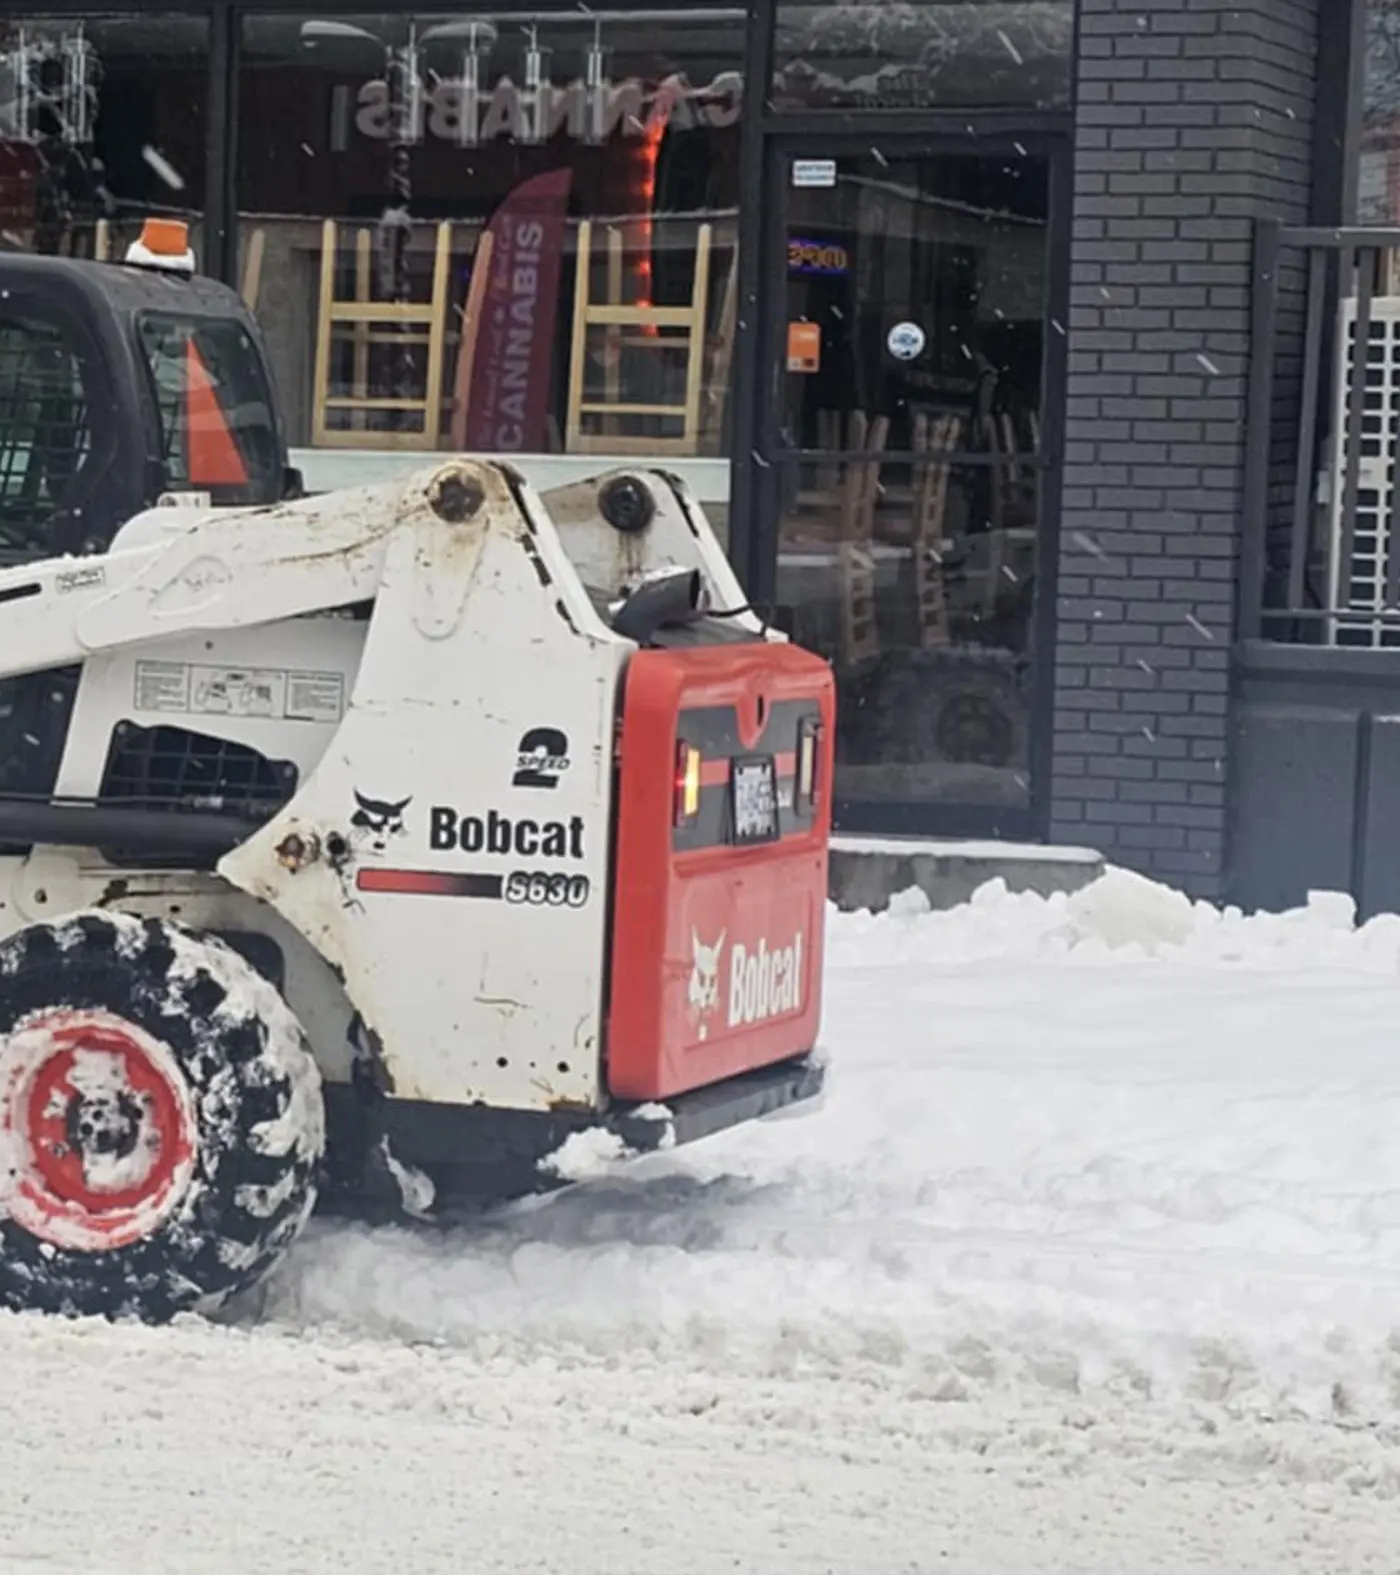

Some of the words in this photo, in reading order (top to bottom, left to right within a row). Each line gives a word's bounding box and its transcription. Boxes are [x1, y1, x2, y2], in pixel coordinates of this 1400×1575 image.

[497, 222, 543, 450] CANNABIS
[512, 727, 568, 789] 2
[516, 755, 571, 771] SPEED
[430, 806, 585, 858] Bobcat
[506, 871, 590, 908] S630
[728, 932, 803, 1028] Bobcat
